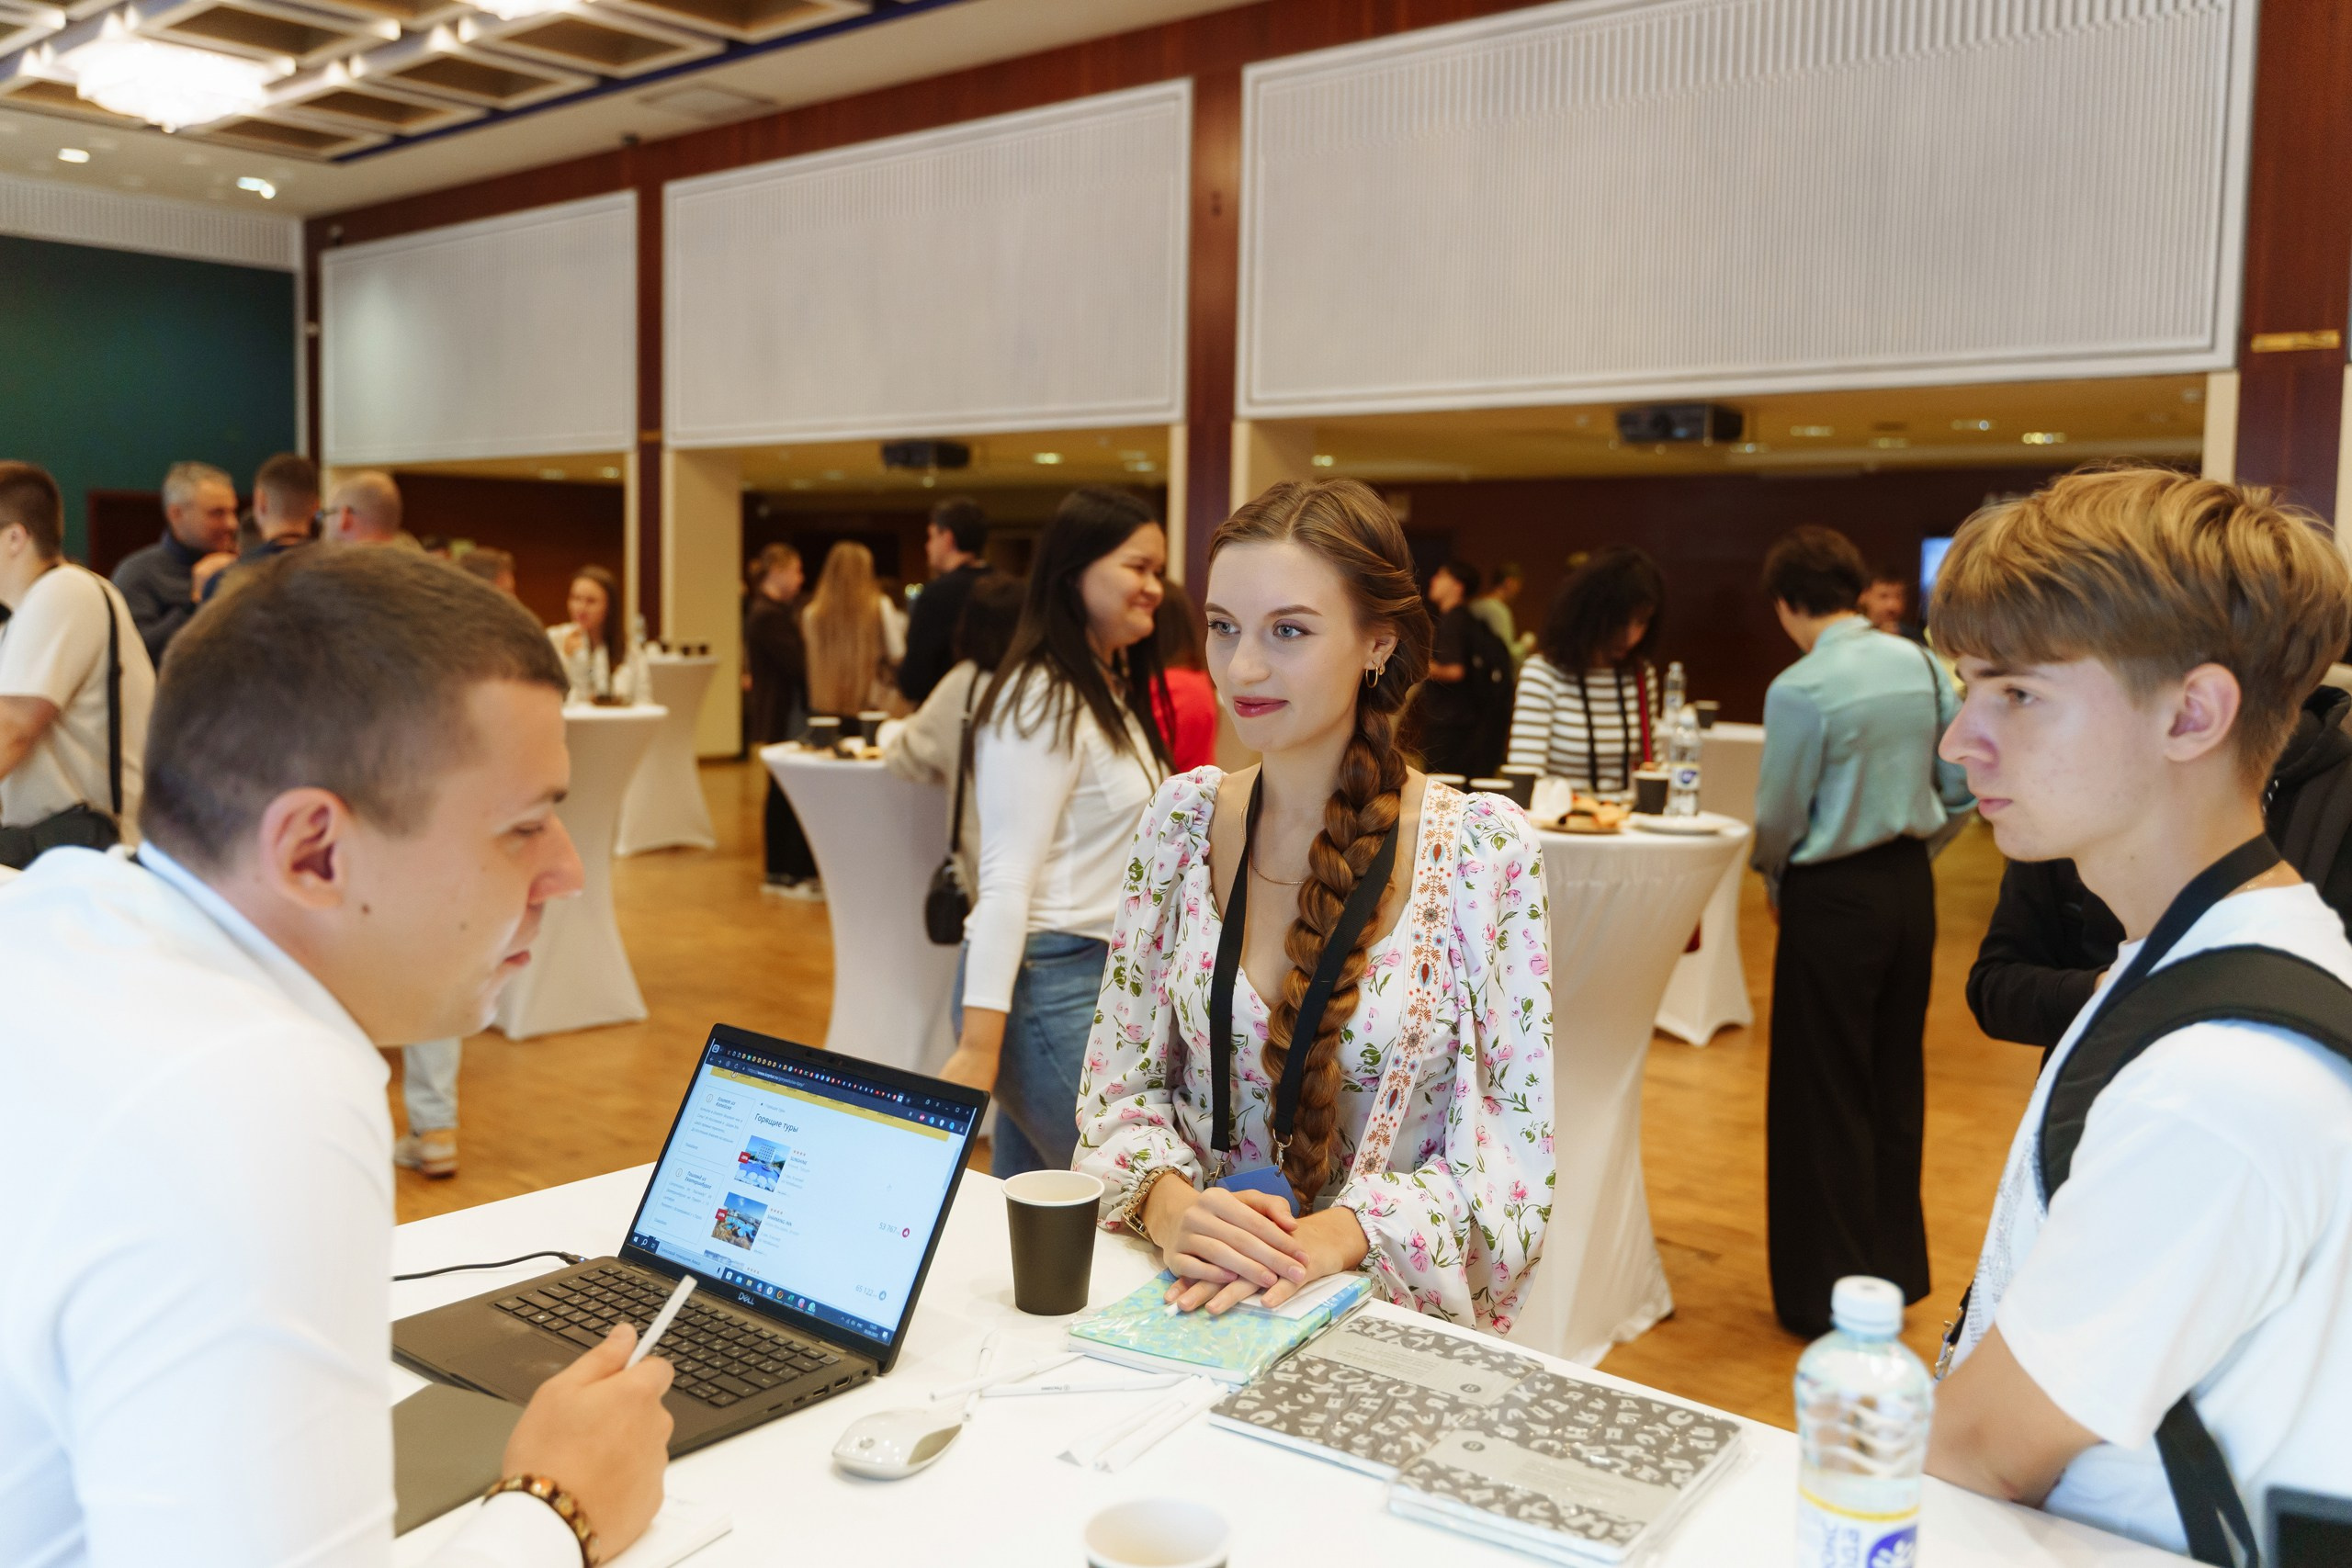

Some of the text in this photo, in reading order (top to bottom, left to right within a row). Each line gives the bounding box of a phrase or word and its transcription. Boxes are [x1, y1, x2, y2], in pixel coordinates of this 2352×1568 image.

[754, 1113, 782, 1128] Горящие
[783, 1122, 799, 1133] туры
[887, 1224, 898, 1233] 767
[864, 1287, 874, 1296] 122
[738, 1292, 754, 1305] DELL
